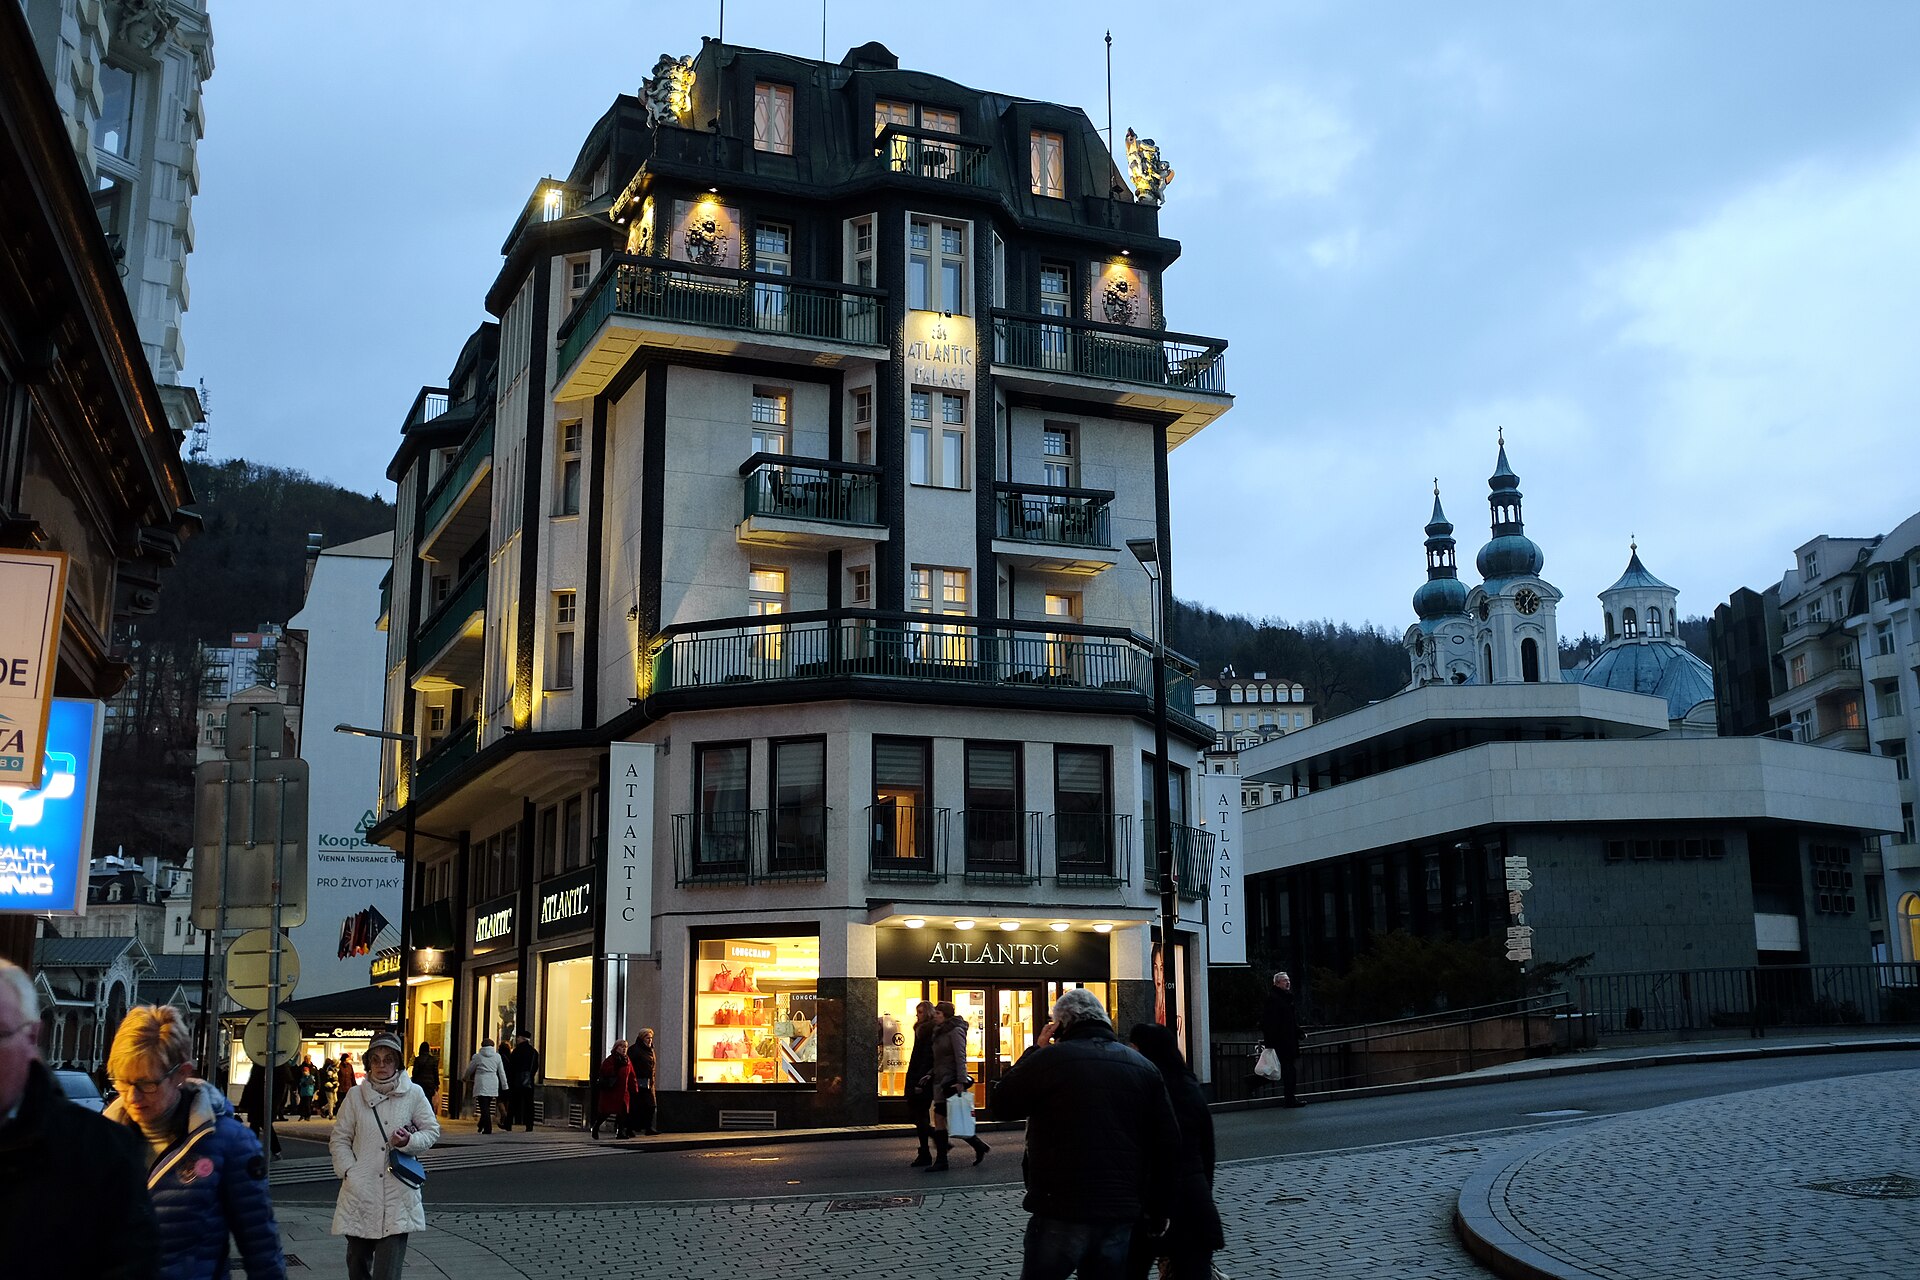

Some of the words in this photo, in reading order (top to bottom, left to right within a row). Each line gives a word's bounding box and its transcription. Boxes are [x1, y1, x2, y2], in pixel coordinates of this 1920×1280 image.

[907, 341, 972, 366] ATLANTIC
[914, 366, 966, 389] PALACE
[622, 763, 639, 922] ATLANTIC
[318, 854, 345, 862] VIENNA
[347, 854, 389, 863] INSURANCE
[1218, 793, 1233, 935] ATLANTIC
[317, 878, 338, 887] PRO
[341, 877, 374, 888] ŽIVOT
[376, 878, 399, 889] JAKÝ
[540, 883, 590, 924] ATLANTIC
[475, 907, 513, 942] ATLANTIC
[731, 946, 771, 959] LONGCHAMP
[928, 941, 1060, 966] ATLANTIC
